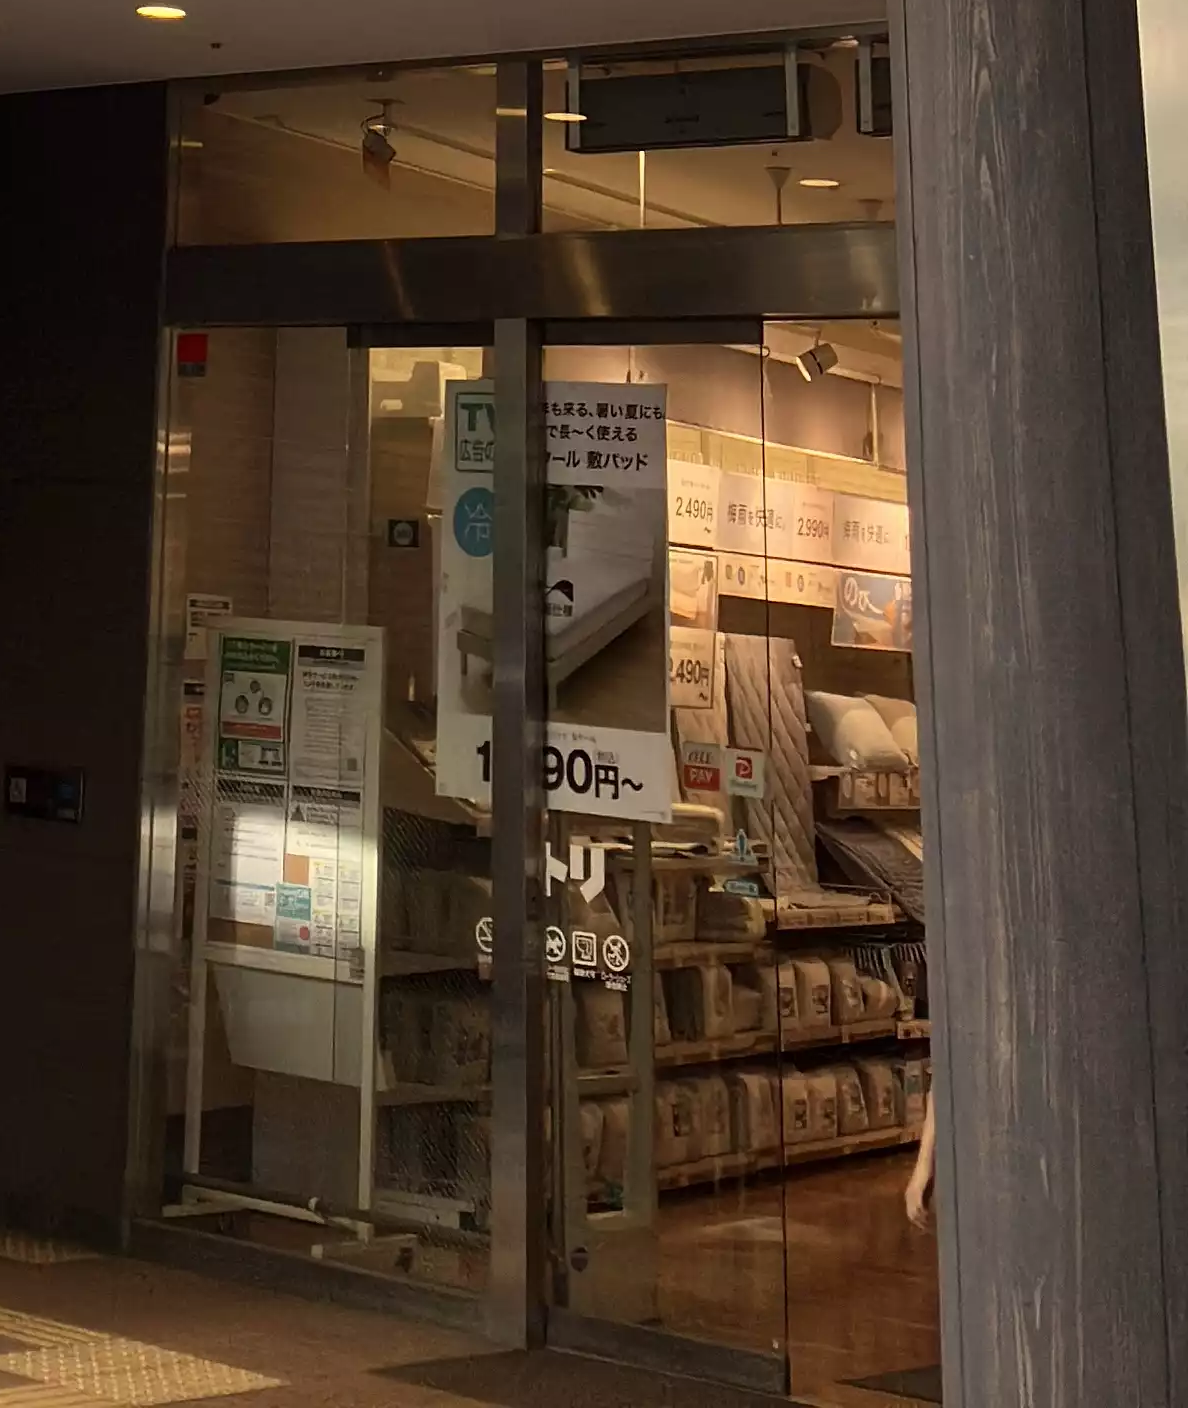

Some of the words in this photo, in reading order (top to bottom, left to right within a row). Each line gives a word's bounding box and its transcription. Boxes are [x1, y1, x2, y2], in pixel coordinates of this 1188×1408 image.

[546, 450, 580, 468] ール
[587, 450, 648, 471] 敷パッド
